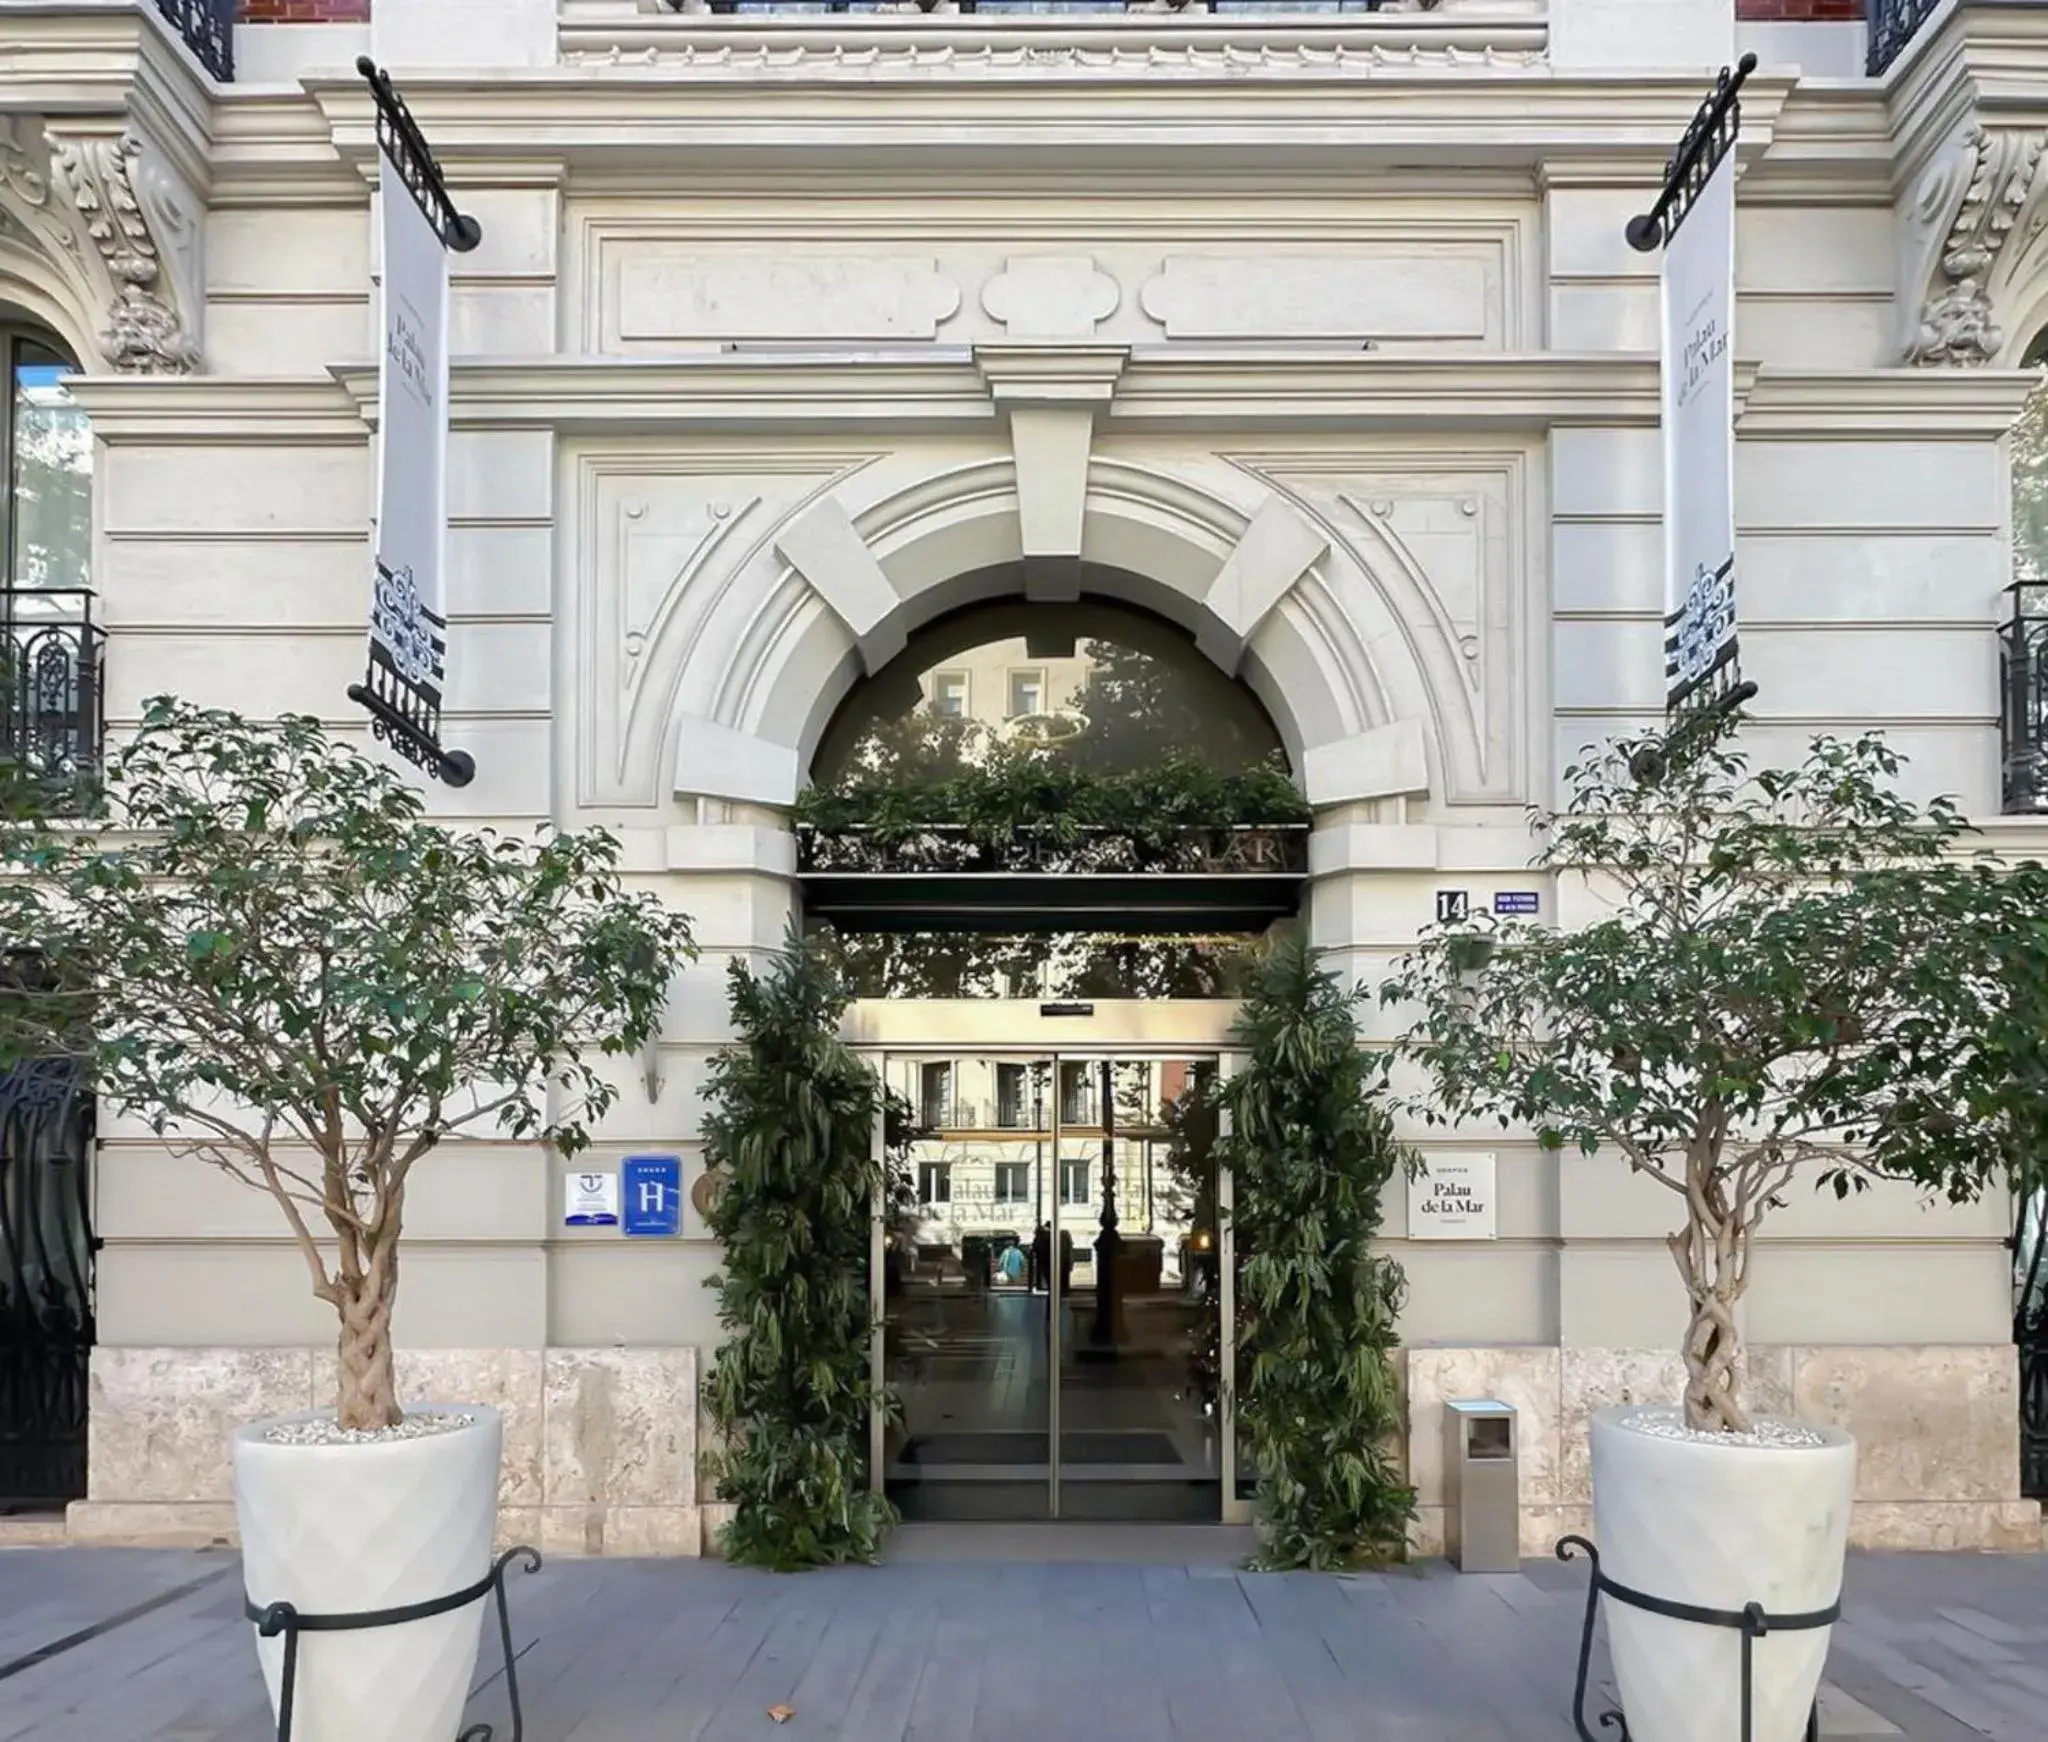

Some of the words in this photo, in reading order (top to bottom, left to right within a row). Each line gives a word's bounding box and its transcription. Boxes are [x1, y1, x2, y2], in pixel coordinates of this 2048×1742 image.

[1439, 893, 1467, 920] 14
[638, 1182, 664, 1213] H
[1434, 1182, 1471, 1196] Palau
[1421, 1199, 1439, 1213] de
[1441, 1199, 1453, 1213] la
[1455, 1199, 1484, 1213] Mar
